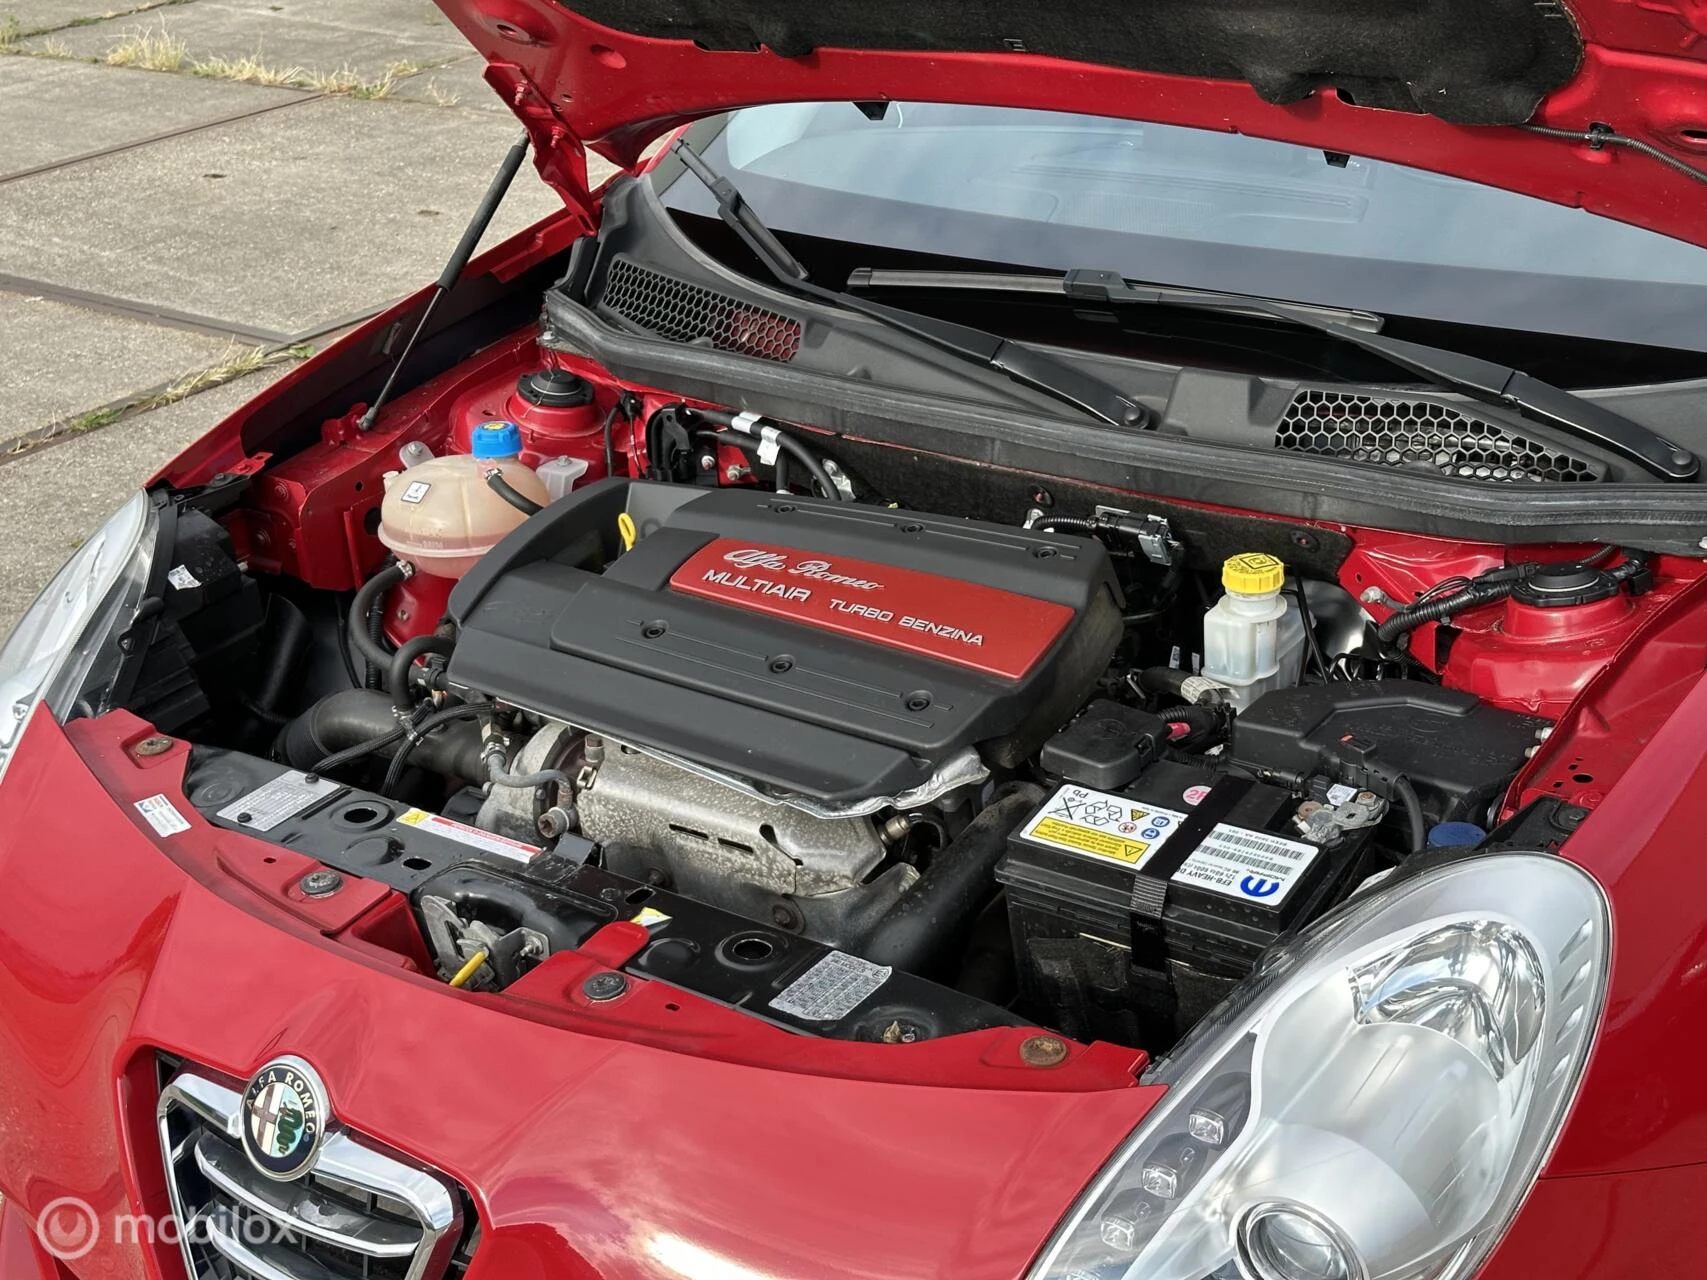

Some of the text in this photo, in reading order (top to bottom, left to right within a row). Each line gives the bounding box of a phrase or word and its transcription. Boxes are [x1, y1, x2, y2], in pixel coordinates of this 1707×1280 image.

[723, 549, 884, 590] Alfa Romeo
[702, 569, 984, 647] MULTIAIR TURBO BENZINA
[1073, 789, 1088, 799] Pb
[246, 1071, 315, 1133] ALFA ROMEO
